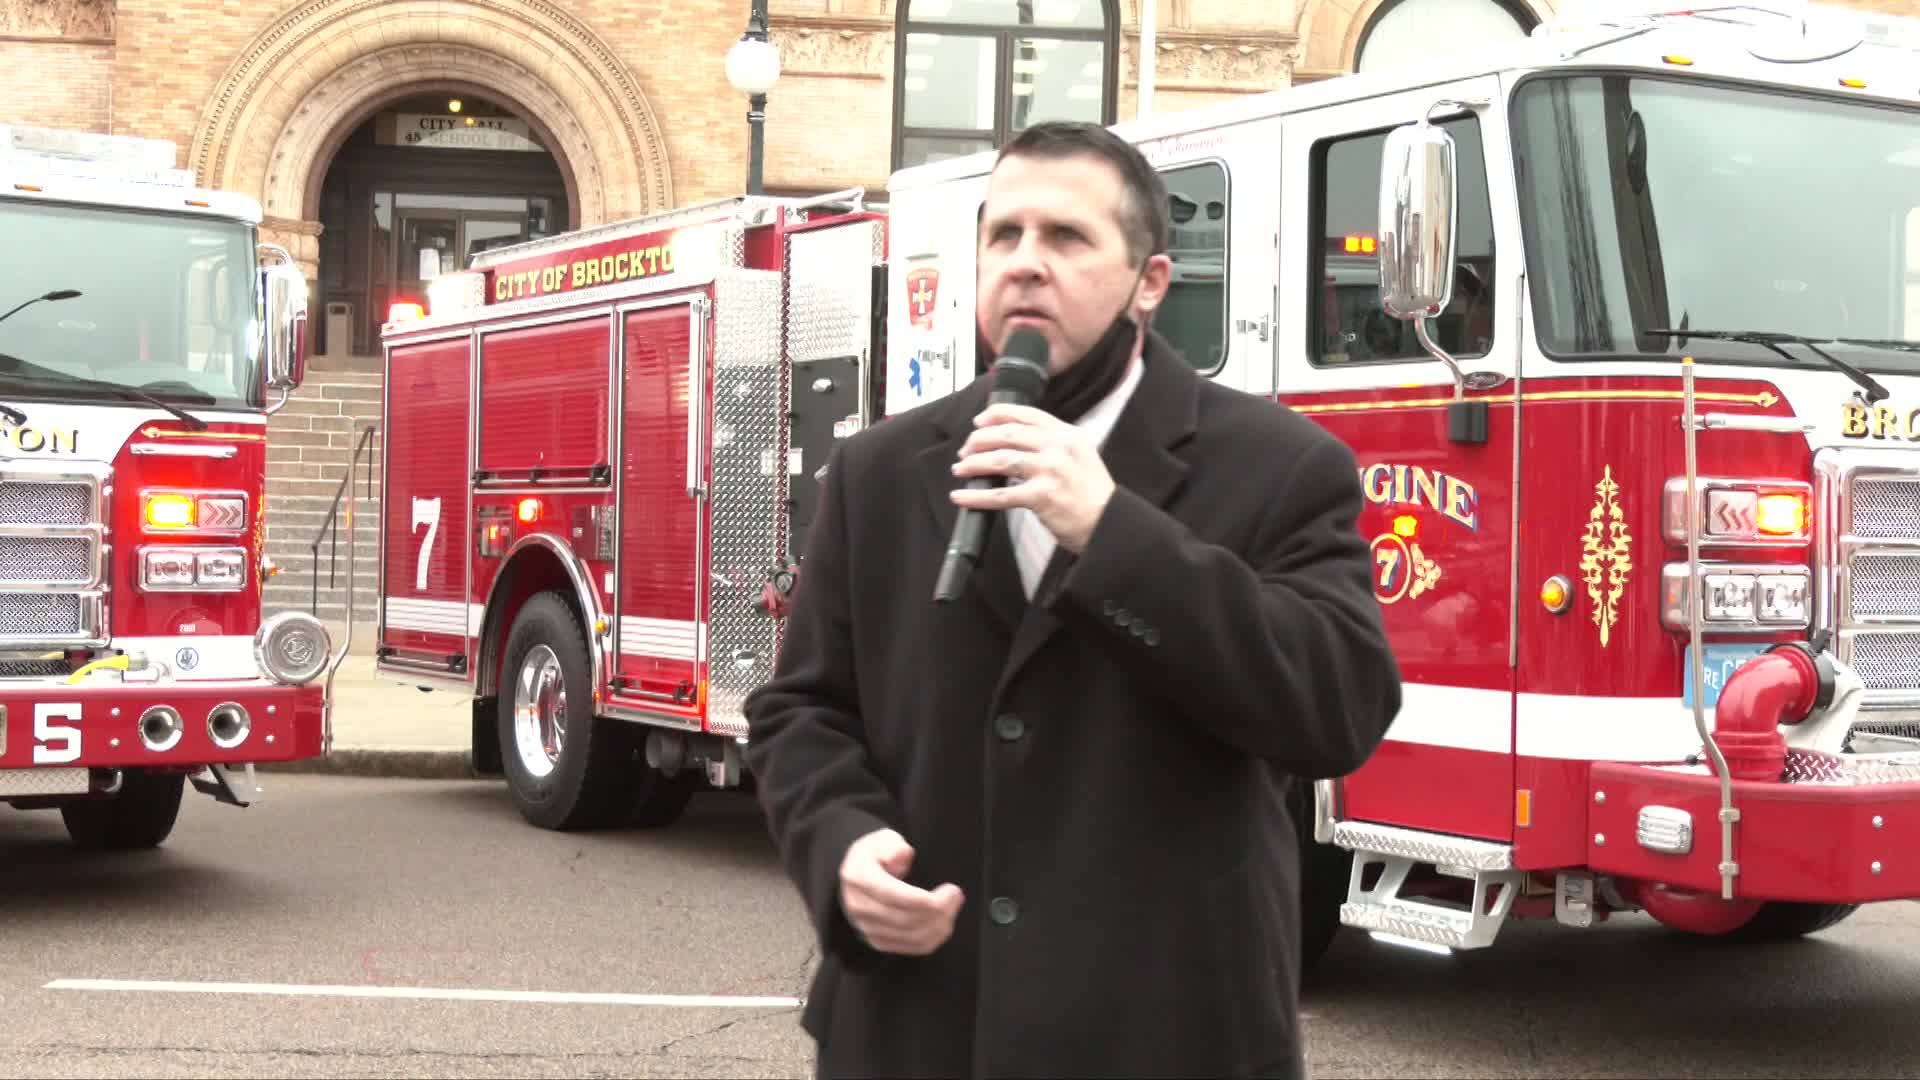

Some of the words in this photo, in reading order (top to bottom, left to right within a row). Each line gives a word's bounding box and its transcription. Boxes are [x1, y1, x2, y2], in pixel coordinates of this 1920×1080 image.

[419, 117, 456, 130] CITY
[464, 119, 507, 131] ALL
[495, 269, 541, 301] CITY
[541, 263, 569, 293] OF
[571, 244, 675, 290] BROCKTO
[3, 426, 79, 454] ON
[1358, 463, 1478, 533] GINE
[411, 495, 442, 592] 7
[1376, 548, 1401, 589] 7
[33, 703, 83, 764] 5
